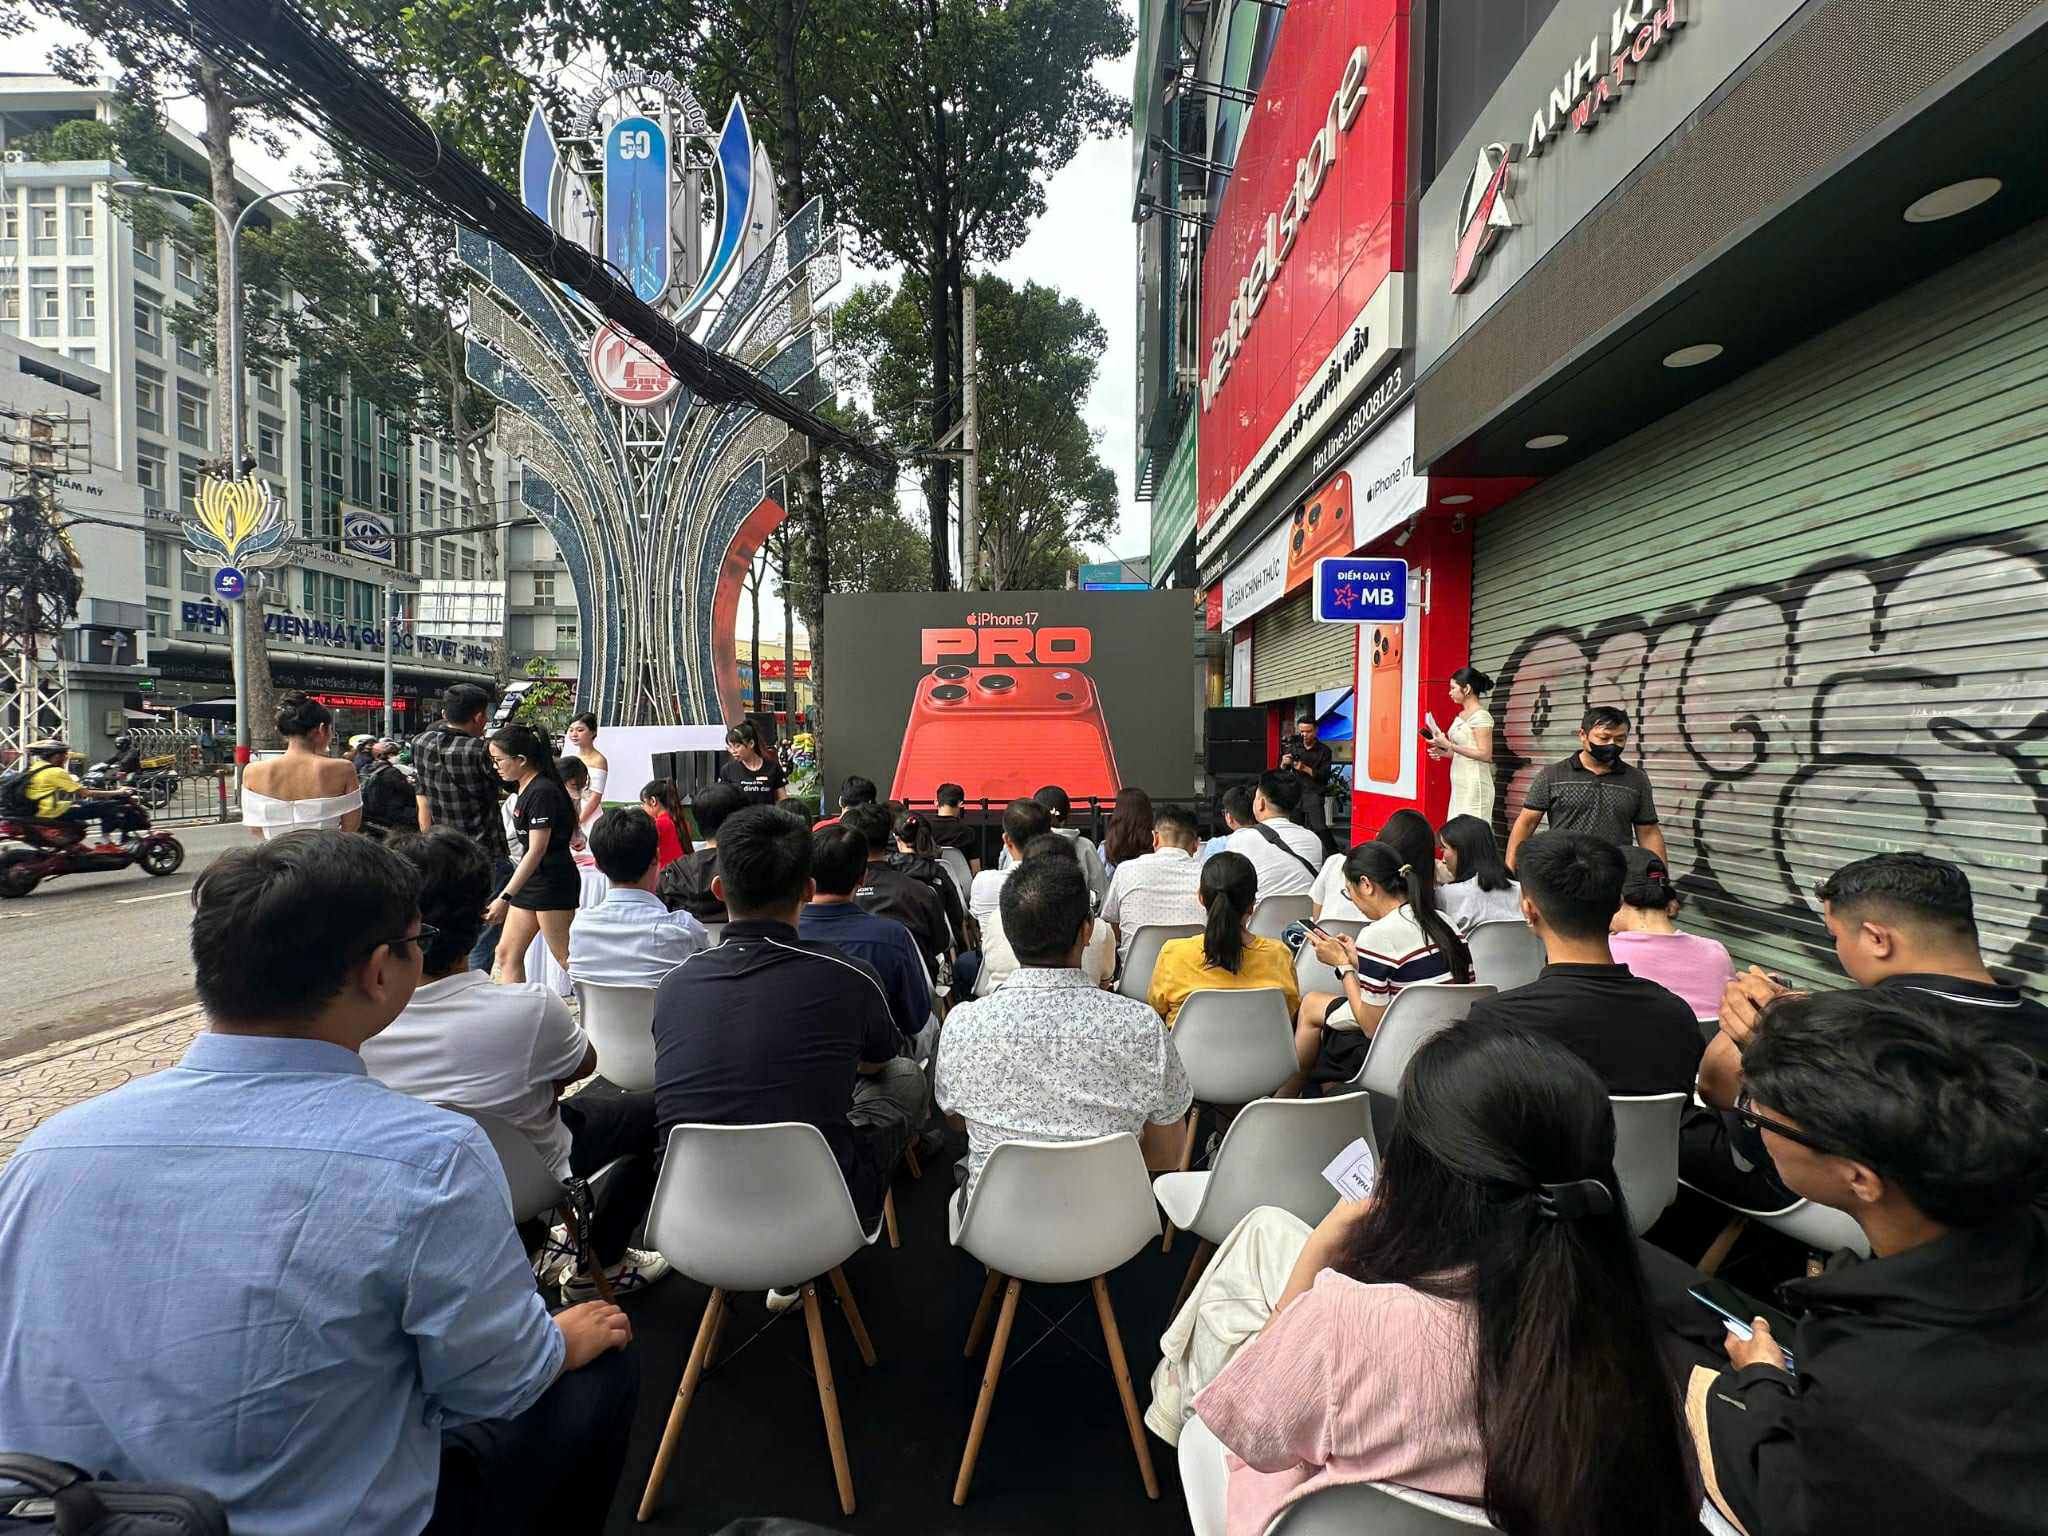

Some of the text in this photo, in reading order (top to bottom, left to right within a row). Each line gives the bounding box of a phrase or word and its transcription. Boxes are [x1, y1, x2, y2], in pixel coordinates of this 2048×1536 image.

[1572, 0, 1675, 134] WATCH
[1527, 34, 1600, 157] ANH
[620, 131, 650, 159] 50
[1372, 455, 1412, 500] iPhone 17
[222, 576, 238, 586] 50
[1362, 571, 1379, 583] ĐẠI
[1361, 588, 1394, 606] MB
[978, 613, 1039, 626] iPhone 17
[921, 627, 1092, 665] PRO
